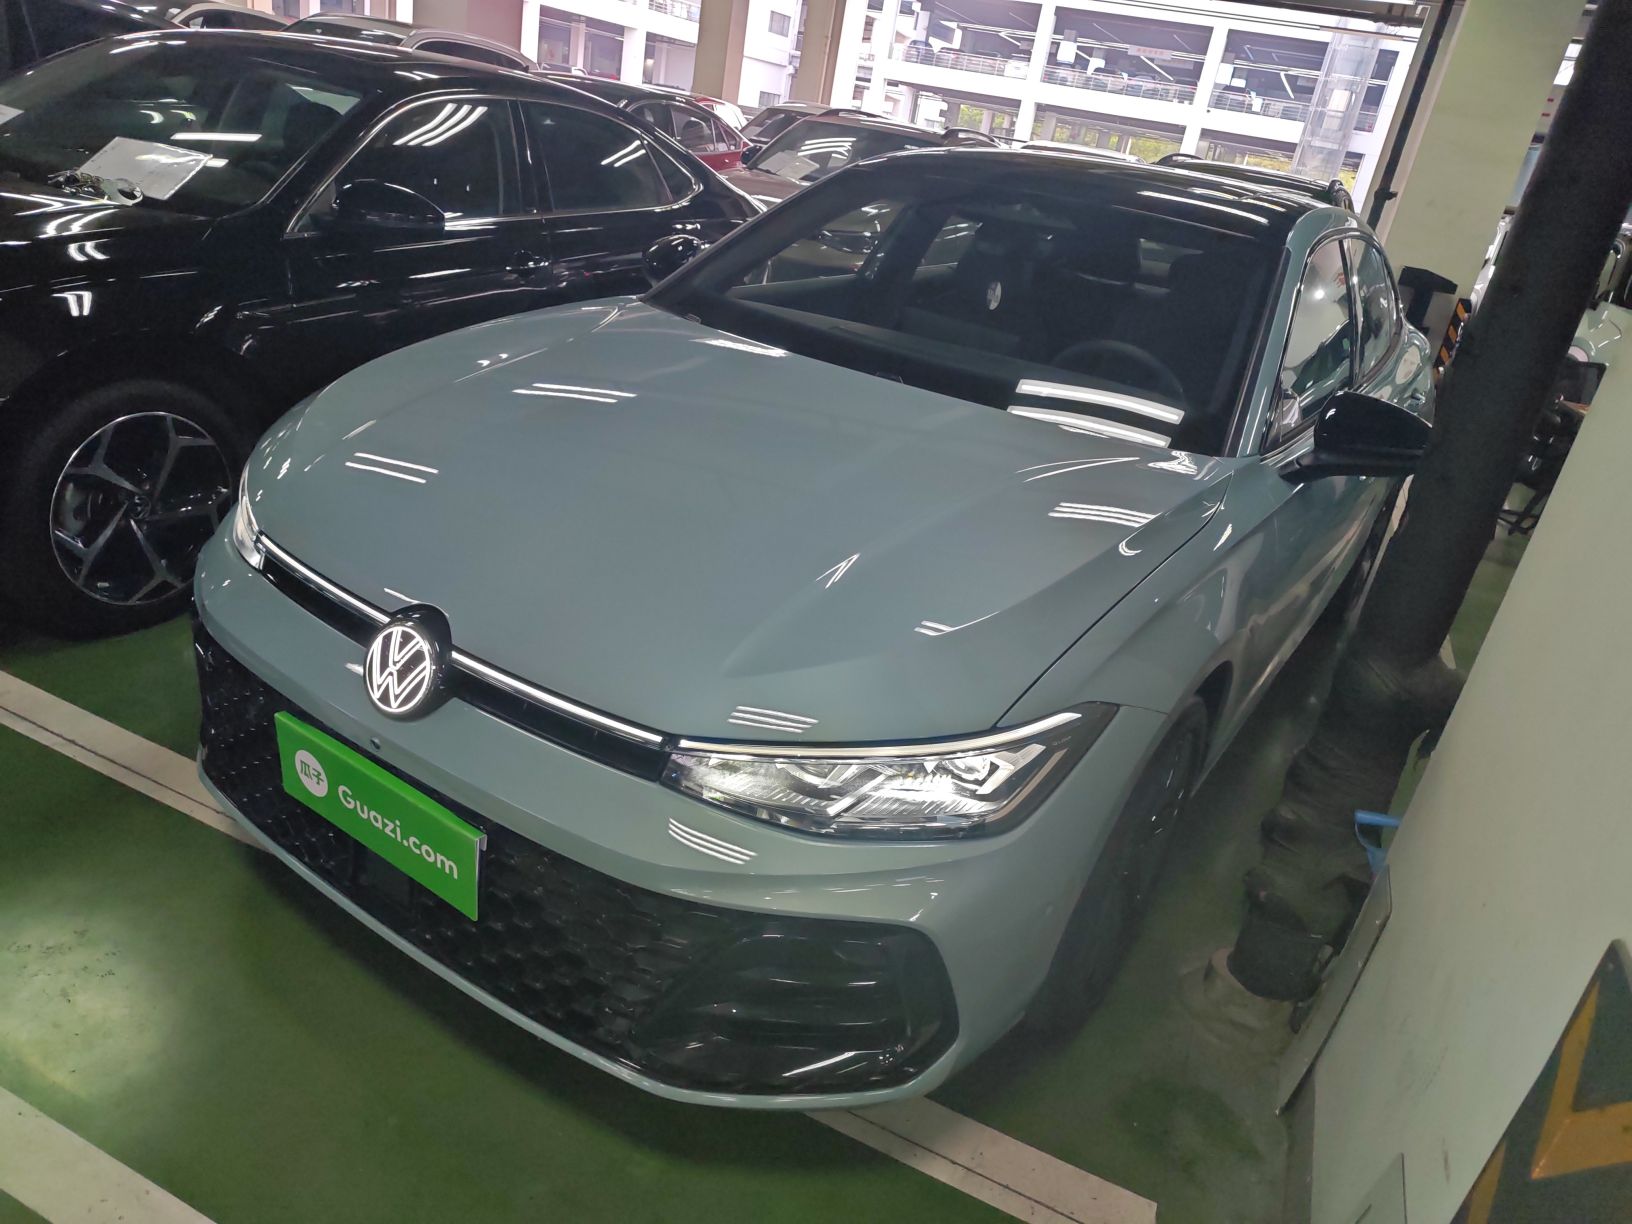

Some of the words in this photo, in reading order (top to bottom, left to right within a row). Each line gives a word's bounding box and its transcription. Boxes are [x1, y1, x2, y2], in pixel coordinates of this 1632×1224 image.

[368, 626, 429, 711] VW
[299, 759, 325, 786] 瓜子
[337, 785, 458, 880] Guazi.com
